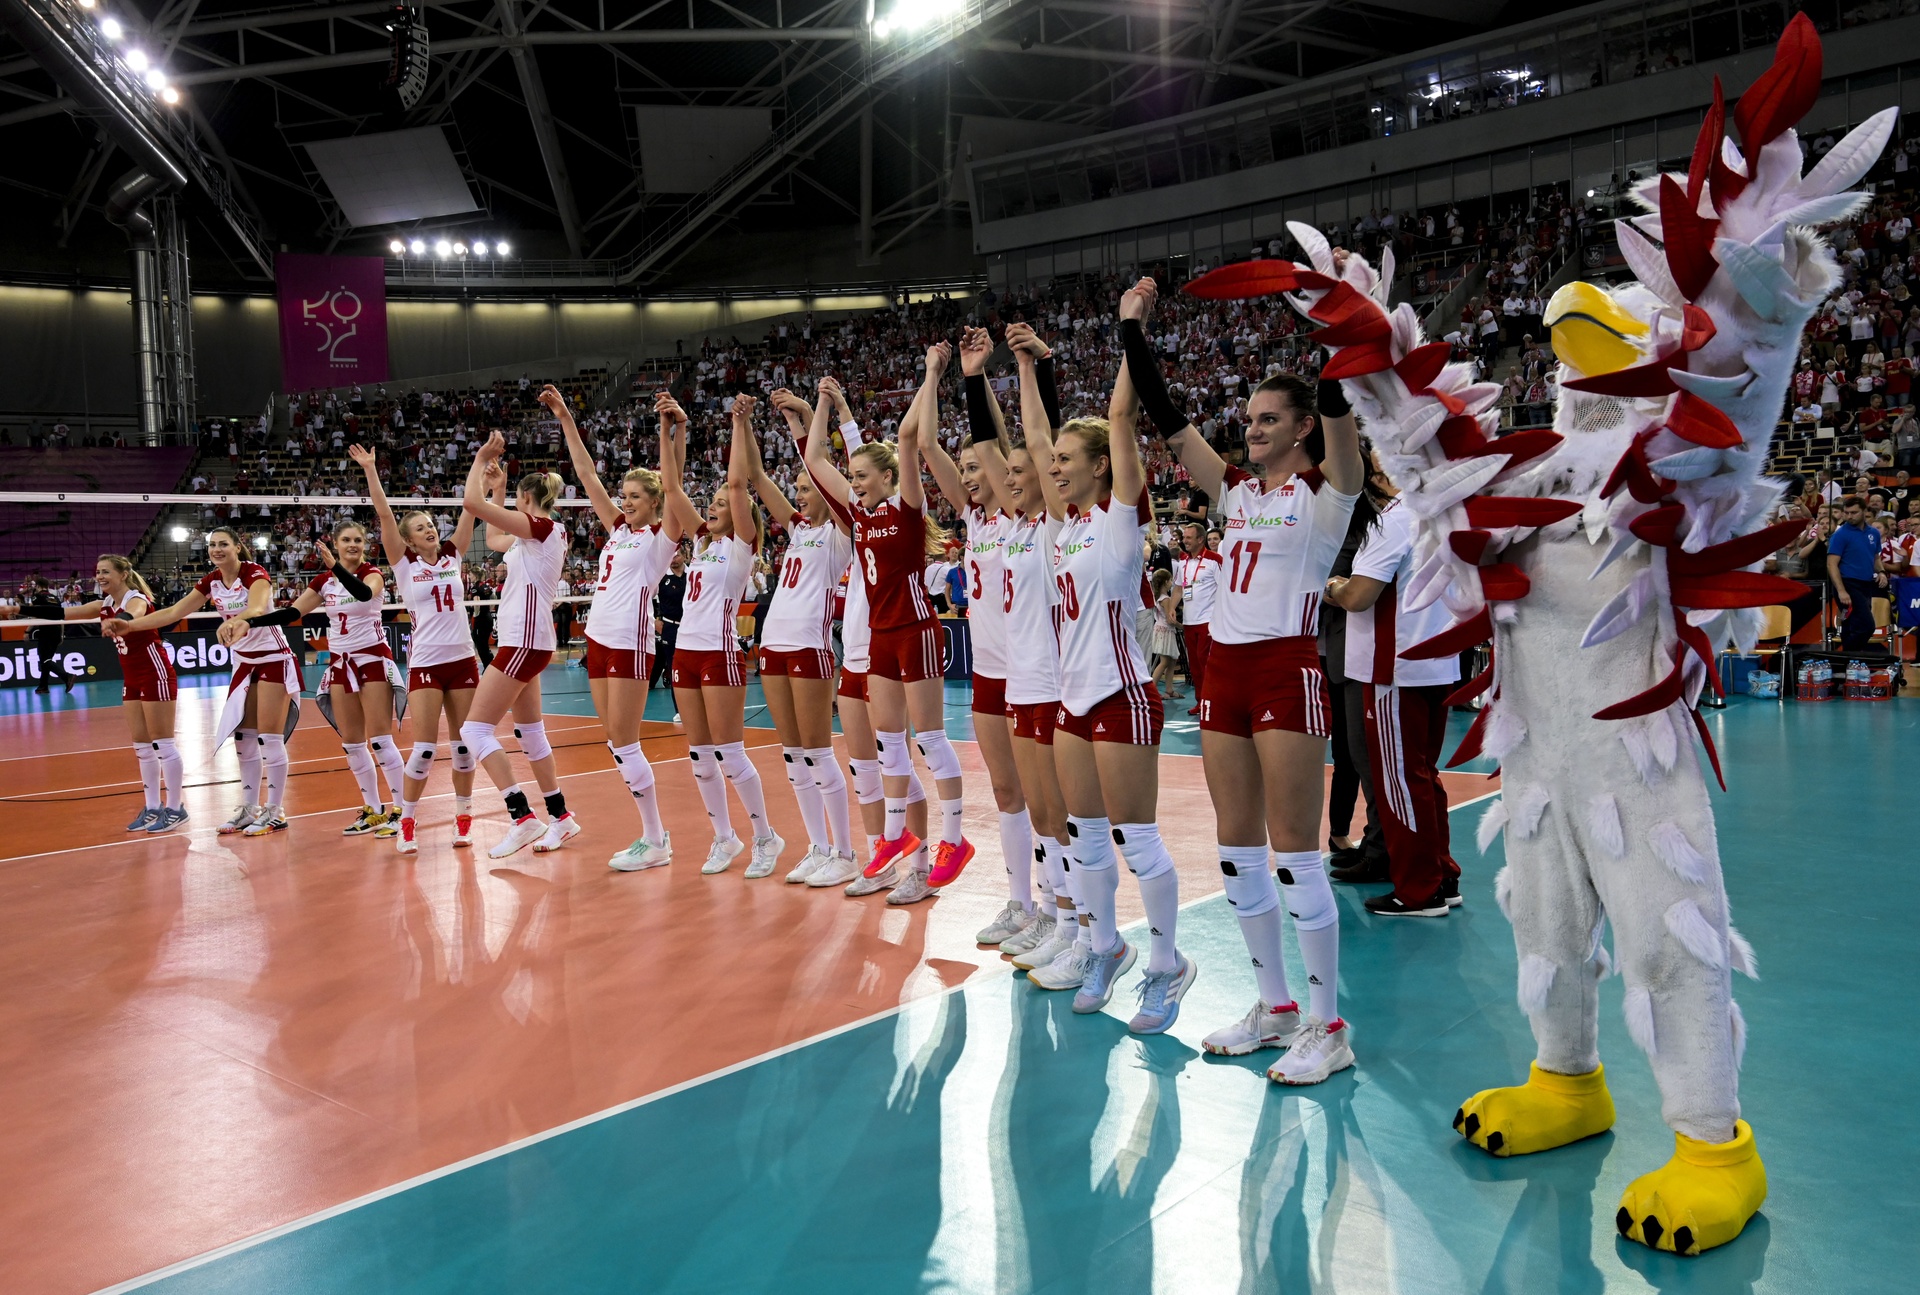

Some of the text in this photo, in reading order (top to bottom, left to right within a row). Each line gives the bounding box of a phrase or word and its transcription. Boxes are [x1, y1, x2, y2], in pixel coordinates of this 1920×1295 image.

[867, 526, 888, 541] plus
[601, 554, 614, 584] 5
[782, 557, 803, 589] 10
[864, 547, 878, 586] 8
[970, 559, 983, 600] 3
[1230, 540, 1262, 594] 17
[430, 583, 455, 613] 14
[687, 570, 703, 602] 16
[338, 612, 349, 636] 2
[419, 672, 432, 684] 14
